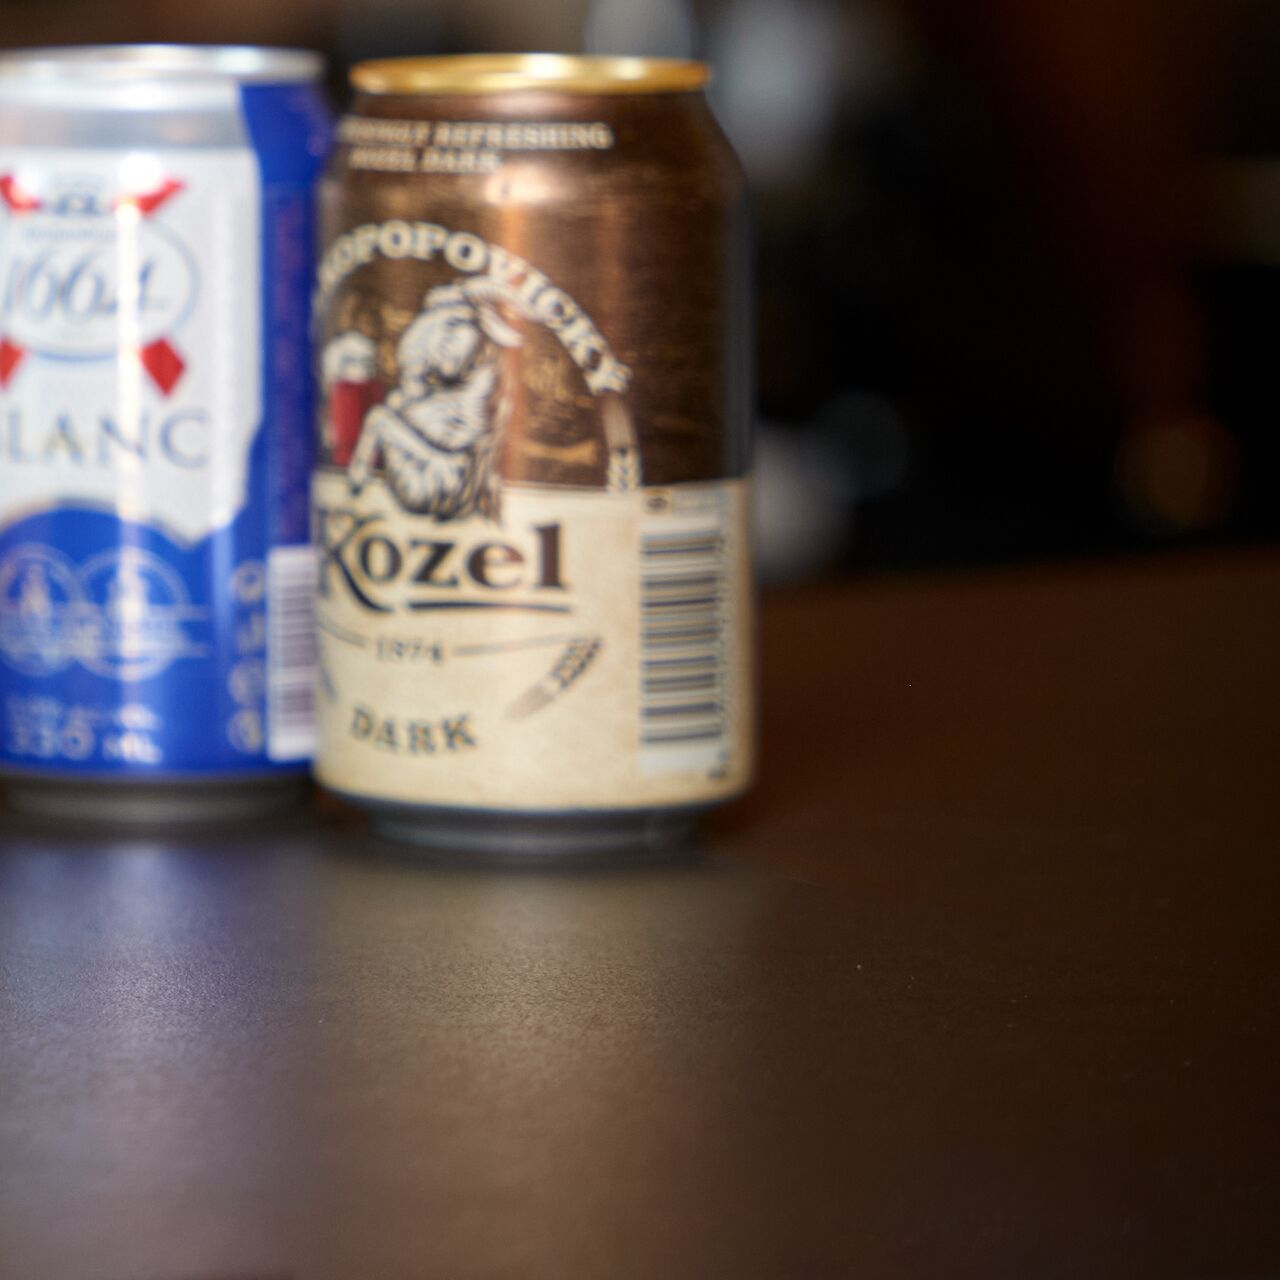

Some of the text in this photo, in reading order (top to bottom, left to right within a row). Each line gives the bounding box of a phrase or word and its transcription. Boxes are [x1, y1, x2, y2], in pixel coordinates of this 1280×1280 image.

[431, 120, 614, 150] REFRESHING
[316, 505, 572, 613] Kozel
[349, 702, 478, 755] DARK
